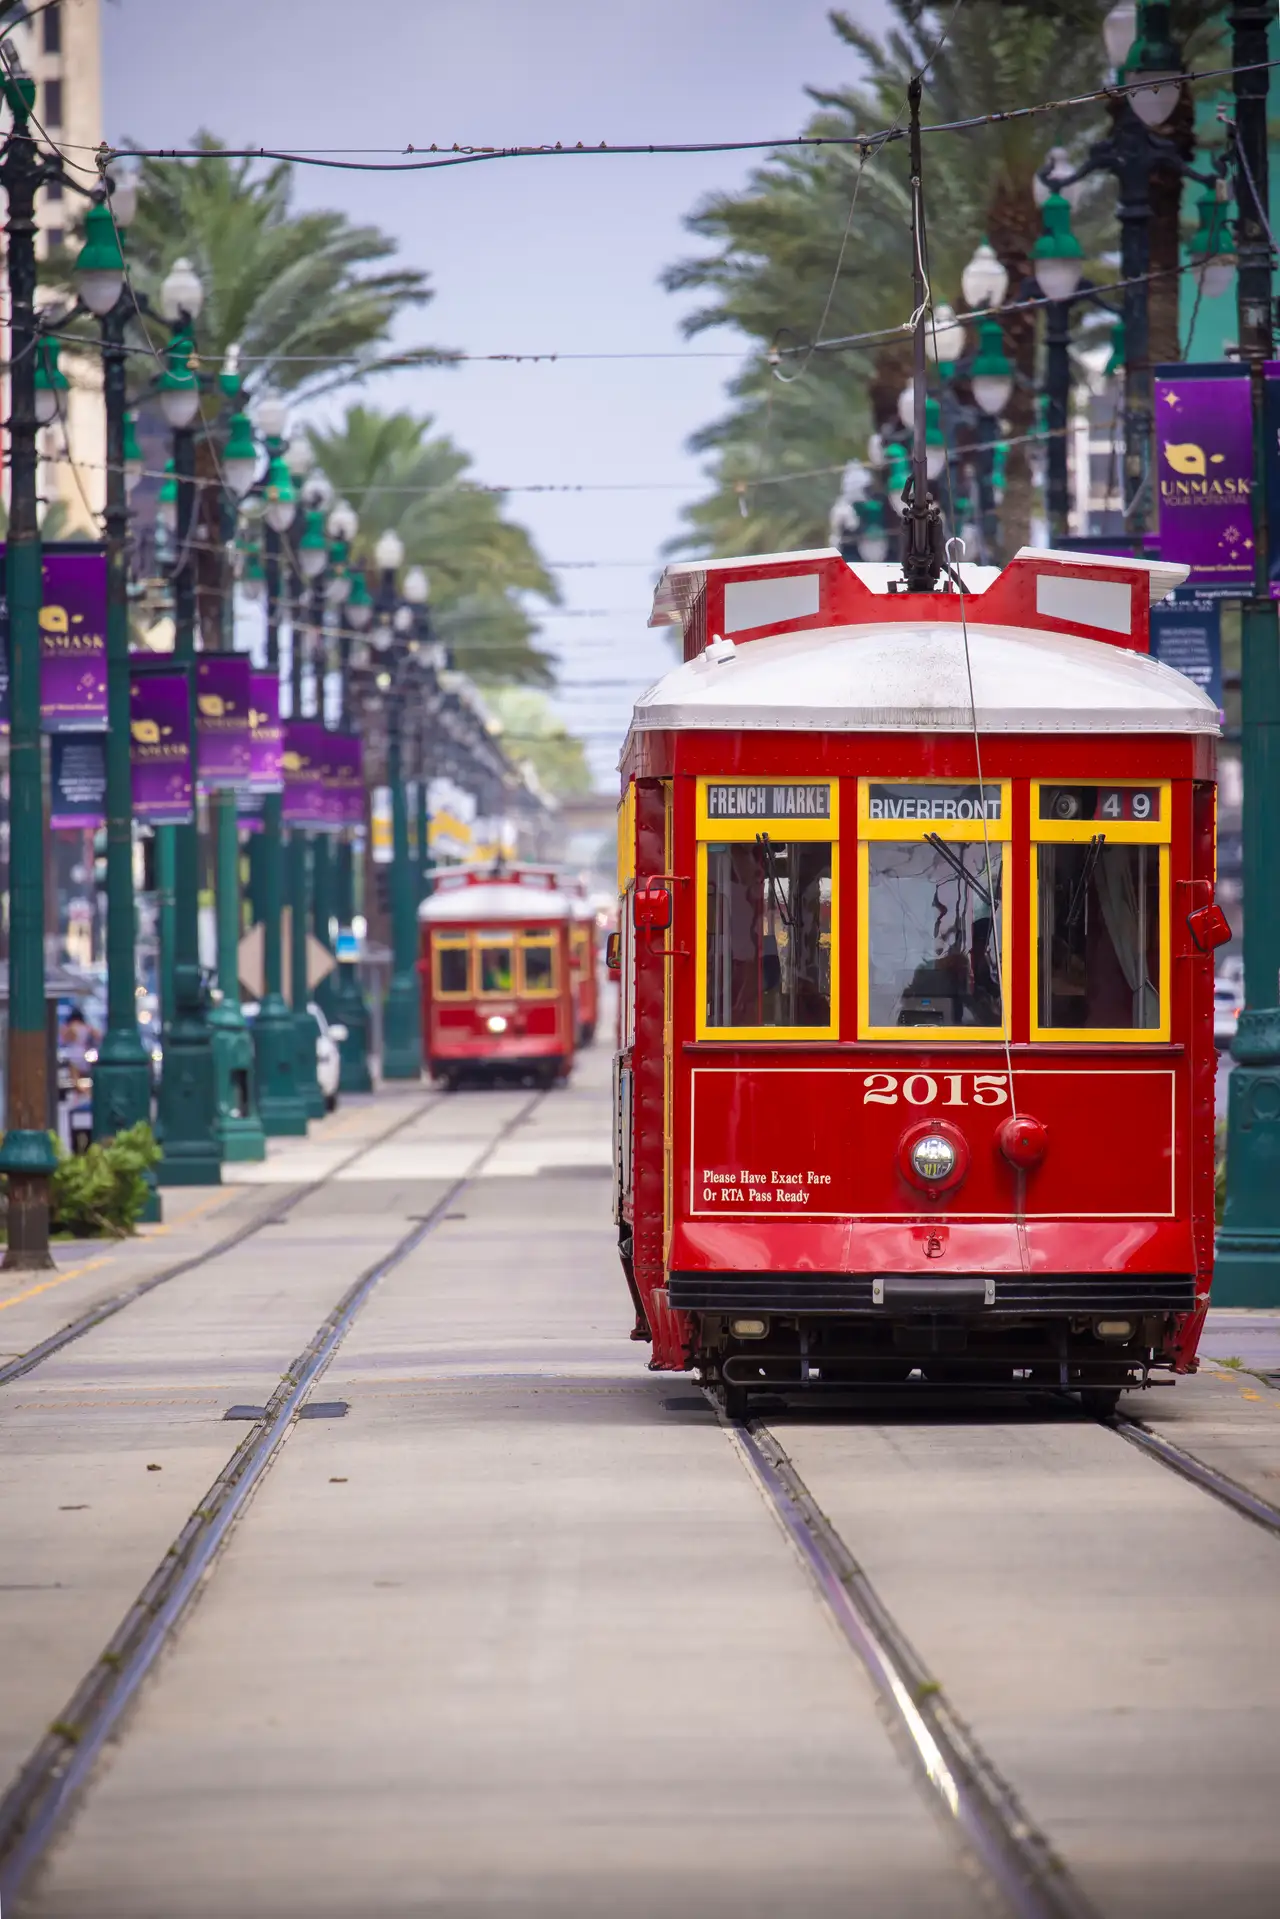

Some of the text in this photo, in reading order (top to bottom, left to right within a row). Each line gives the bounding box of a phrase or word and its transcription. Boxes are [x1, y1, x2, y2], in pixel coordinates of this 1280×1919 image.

[1160, 478, 1250, 495] UNMASK
[709, 787, 766, 815] FRENCH
[869, 799, 1001, 820] RIVERFRONT
[863, 1074, 1008, 1106] 2015
[703, 1170, 831, 1184] Please Have Exact Fare
[703, 1188, 810, 1204] Or RTA Pass Ready
